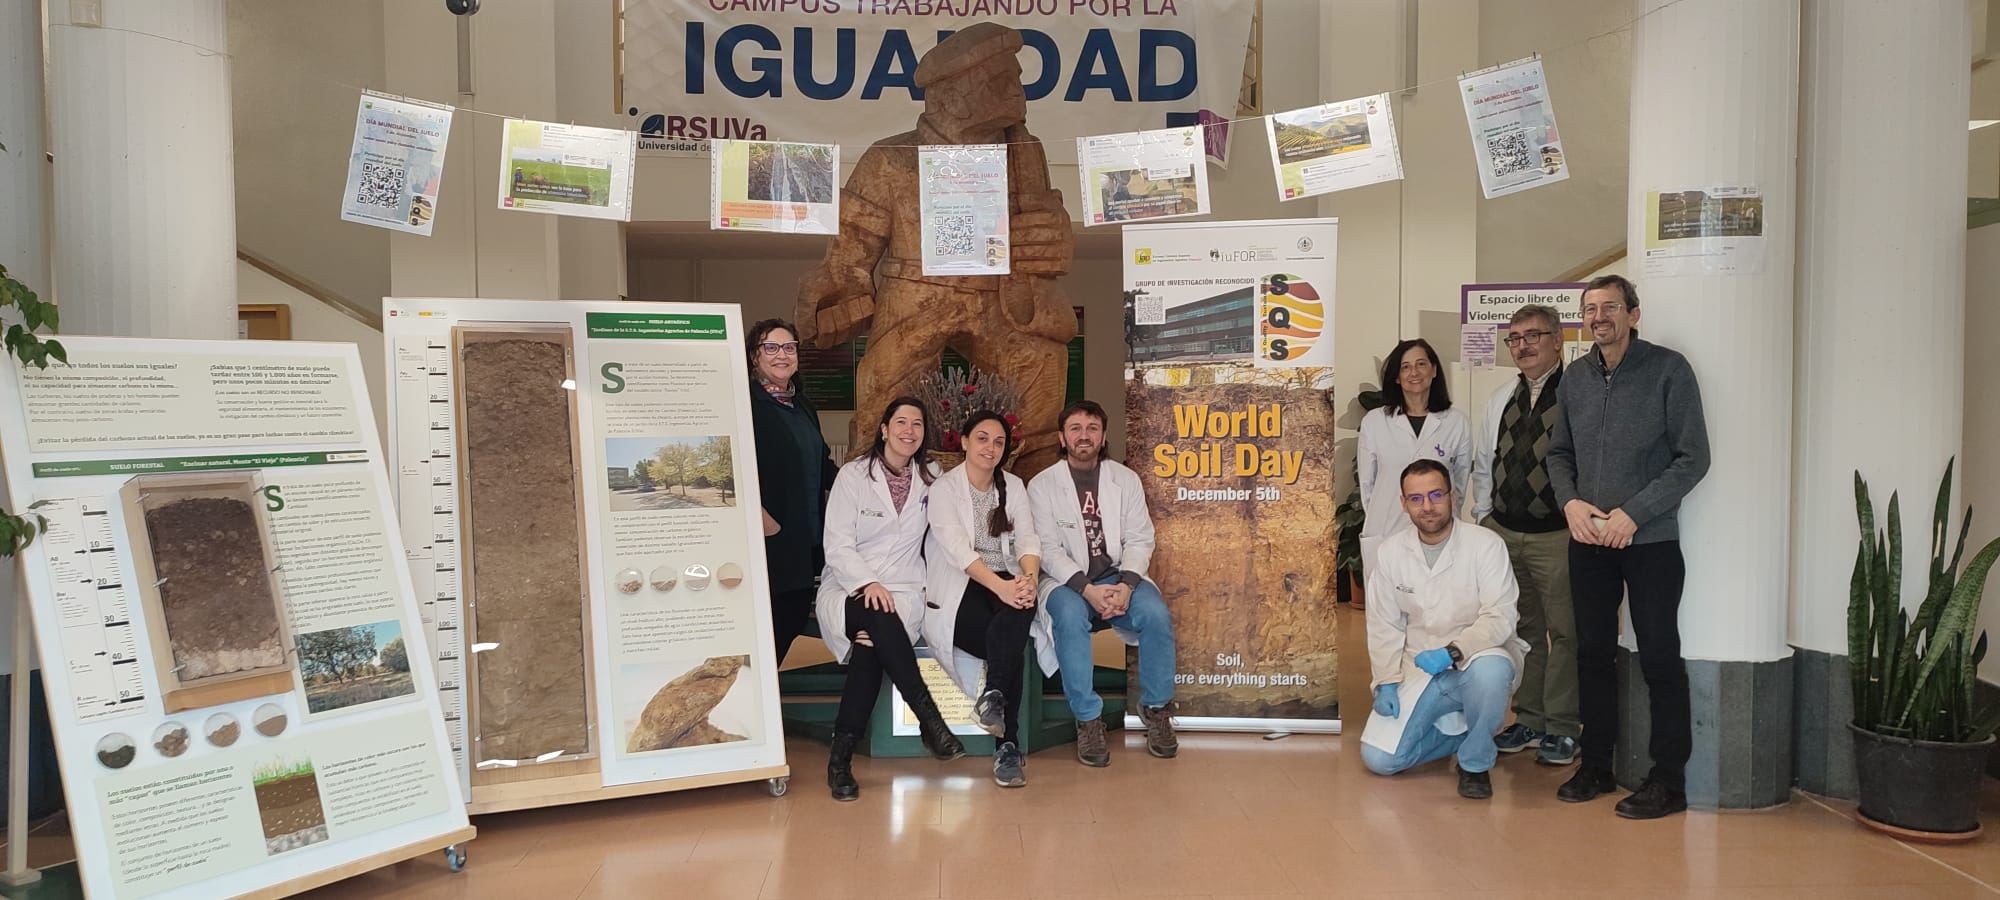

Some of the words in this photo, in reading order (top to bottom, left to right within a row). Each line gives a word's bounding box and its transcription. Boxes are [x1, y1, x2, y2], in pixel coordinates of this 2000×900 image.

[685, 21, 1198, 101] IGUADAD
[638, 140, 697, 152] Universidad
[1480, 294, 1525, 306] Espacio
[1527, 293, 1553, 304] libre
[1556, 293, 1571, 303] de
[1469, 311, 1515, 321] Violenci
[600, 362, 625, 394] S
[1173, 404, 1282, 439] World
[1153, 443, 1222, 479] Soil
[1235, 443, 1304, 485] Day
[263, 485, 285, 512] S
[1177, 486, 1252, 501] December
[1255, 486, 1281, 501] 5th
[112, 652, 122, 660] 40
[1216, 653, 1245, 669] Soil,
[1174, 675, 1195, 685] ere
[1198, 671, 1266, 688] everything
[1270, 672, 1308, 687] starts
[120, 690, 130, 698] 50
